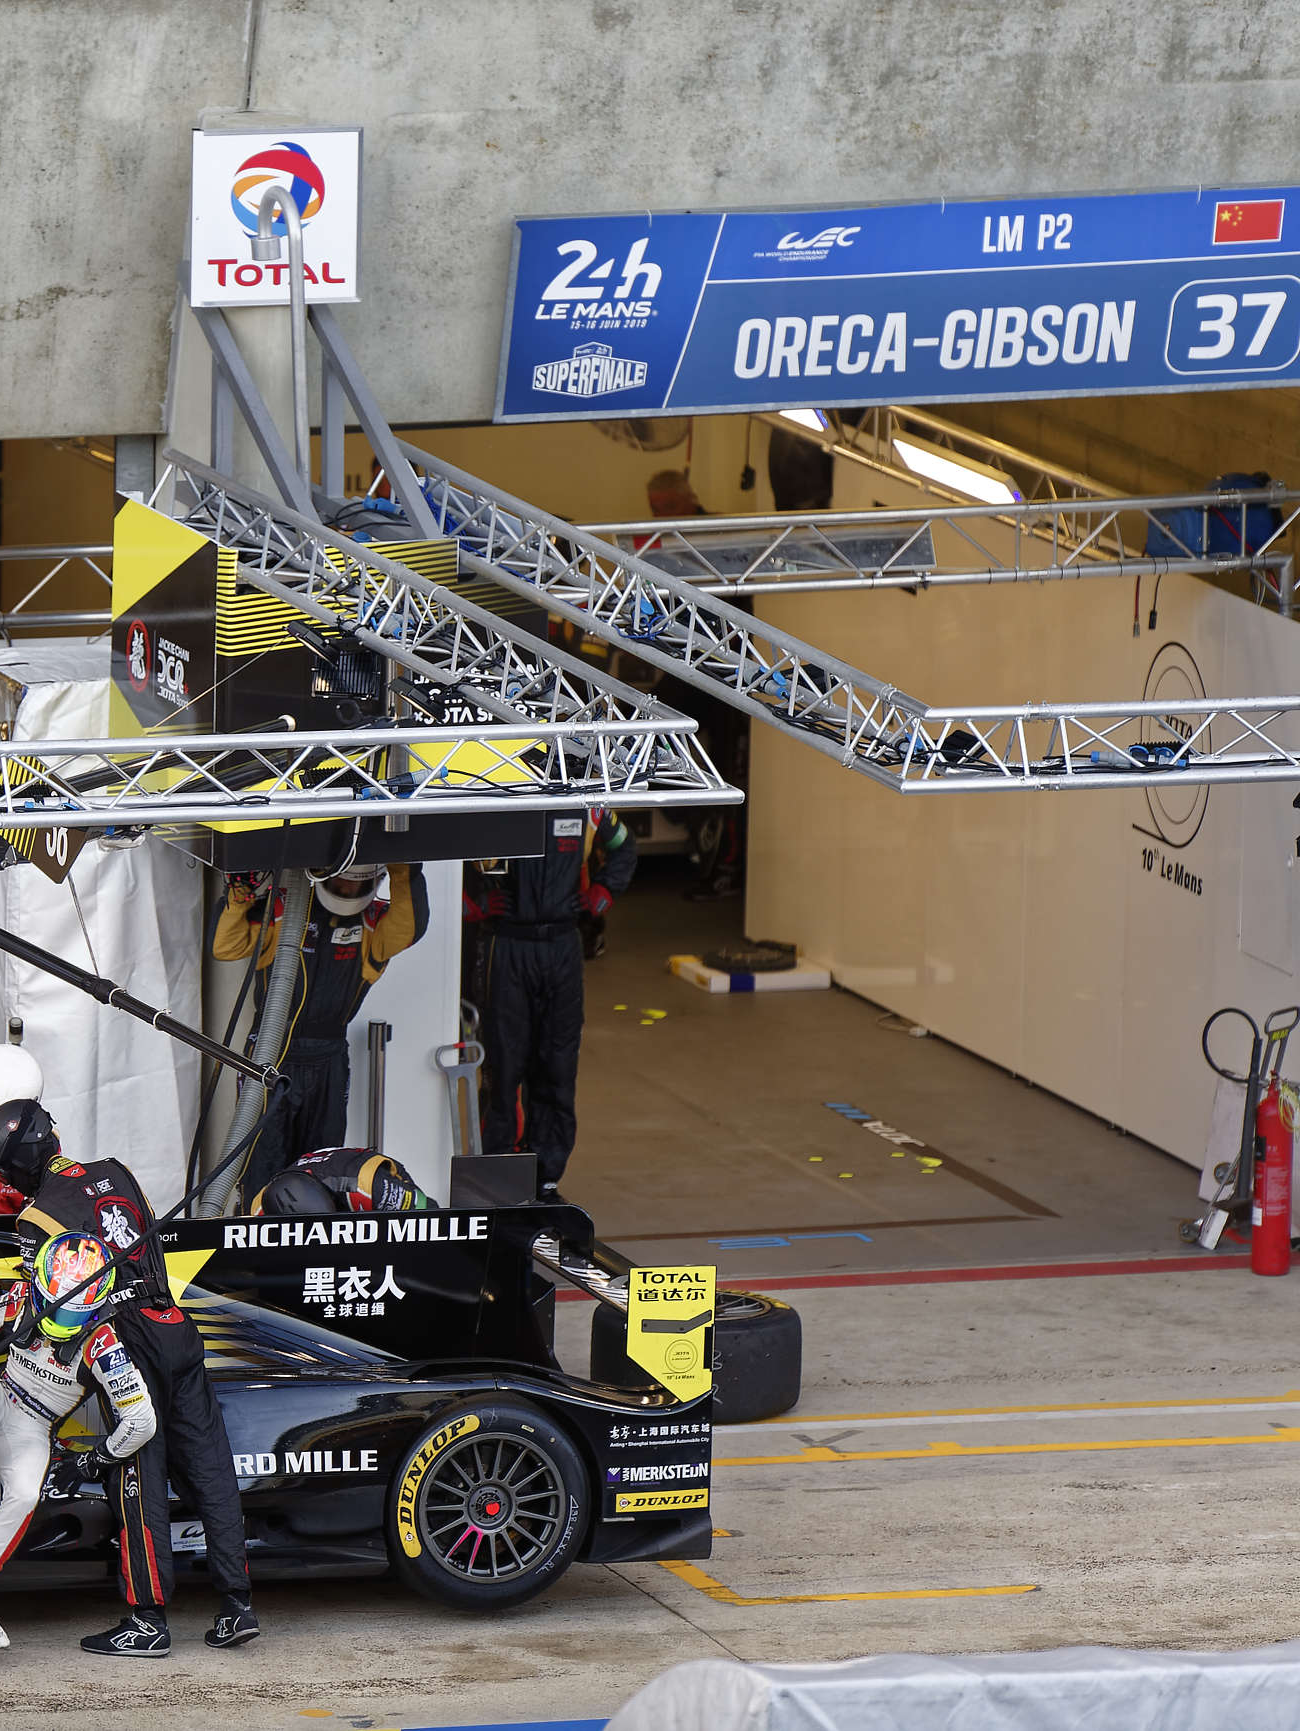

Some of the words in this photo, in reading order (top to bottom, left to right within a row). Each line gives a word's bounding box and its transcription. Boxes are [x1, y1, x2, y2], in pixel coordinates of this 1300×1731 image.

[777, 226, 861, 249] WEC
[982, 215, 1025, 253] LM
[1037, 213, 1074, 250] P2
[542, 237, 662, 300] 24h
[535, 303, 570, 320] LE
[572, 301, 652, 319] MANS
[570, 320, 597, 330] 15-16
[599, 320, 621, 329] JUIN
[624, 319, 648, 328] 2019
[1187, 291, 1288, 360] 37
[734, 300, 1136, 379] ORECA-GIBSON
[535, 357, 645, 395] SUPERFINALE
[1161, 856, 1172, 881] Le
[1174, 862, 1203, 896] Mans
[223, 1220, 379, 1249] RICHARD
[386, 1216, 489, 1243] MILLE
[303, 1265, 406, 1303] 黑衣人
[637, 1288, 707, 1302] 道达尔
[638, 1271, 706, 1284] TOTAL
[285, 1450, 379, 1474] MILLE
[399, 1418, 466, 1527] DUNLOP
[633, 1494, 705, 1507] DUNLOP
